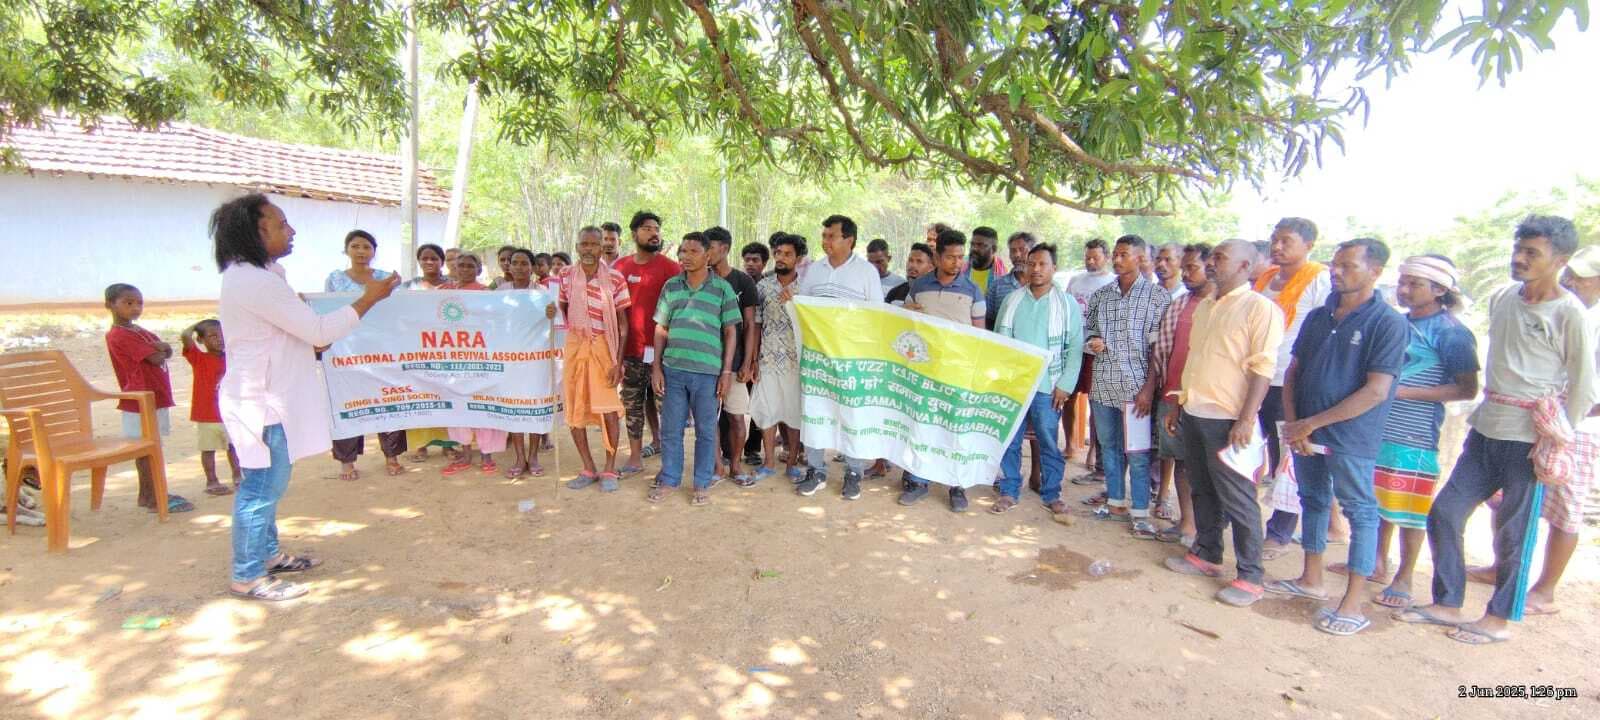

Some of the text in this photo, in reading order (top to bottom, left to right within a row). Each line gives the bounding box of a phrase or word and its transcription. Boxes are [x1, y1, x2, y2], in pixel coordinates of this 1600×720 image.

[421, 331, 486, 348] NARA
[332, 353, 396, 368] (NATIONAL
[399, 351, 447, 362] ADIWASI
[451, 351, 490, 361] REVIVAL
[382, 385, 413, 395] SASS
[344, 398, 371, 409] (SINGI
[382, 394, 406, 403] SINGI
[408, 392, 441, 400] SOCIETY)
[888, 381, 925, 406] समाज
[927, 396, 954, 413] युवा
[955, 407, 1008, 426] महासभा
[348, 408, 373, 417] REGD.
[864, 395, 903, 410] SAMAJ
[905, 403, 930, 423] YUVA
[932, 415, 1001, 438] MAHASABHA
